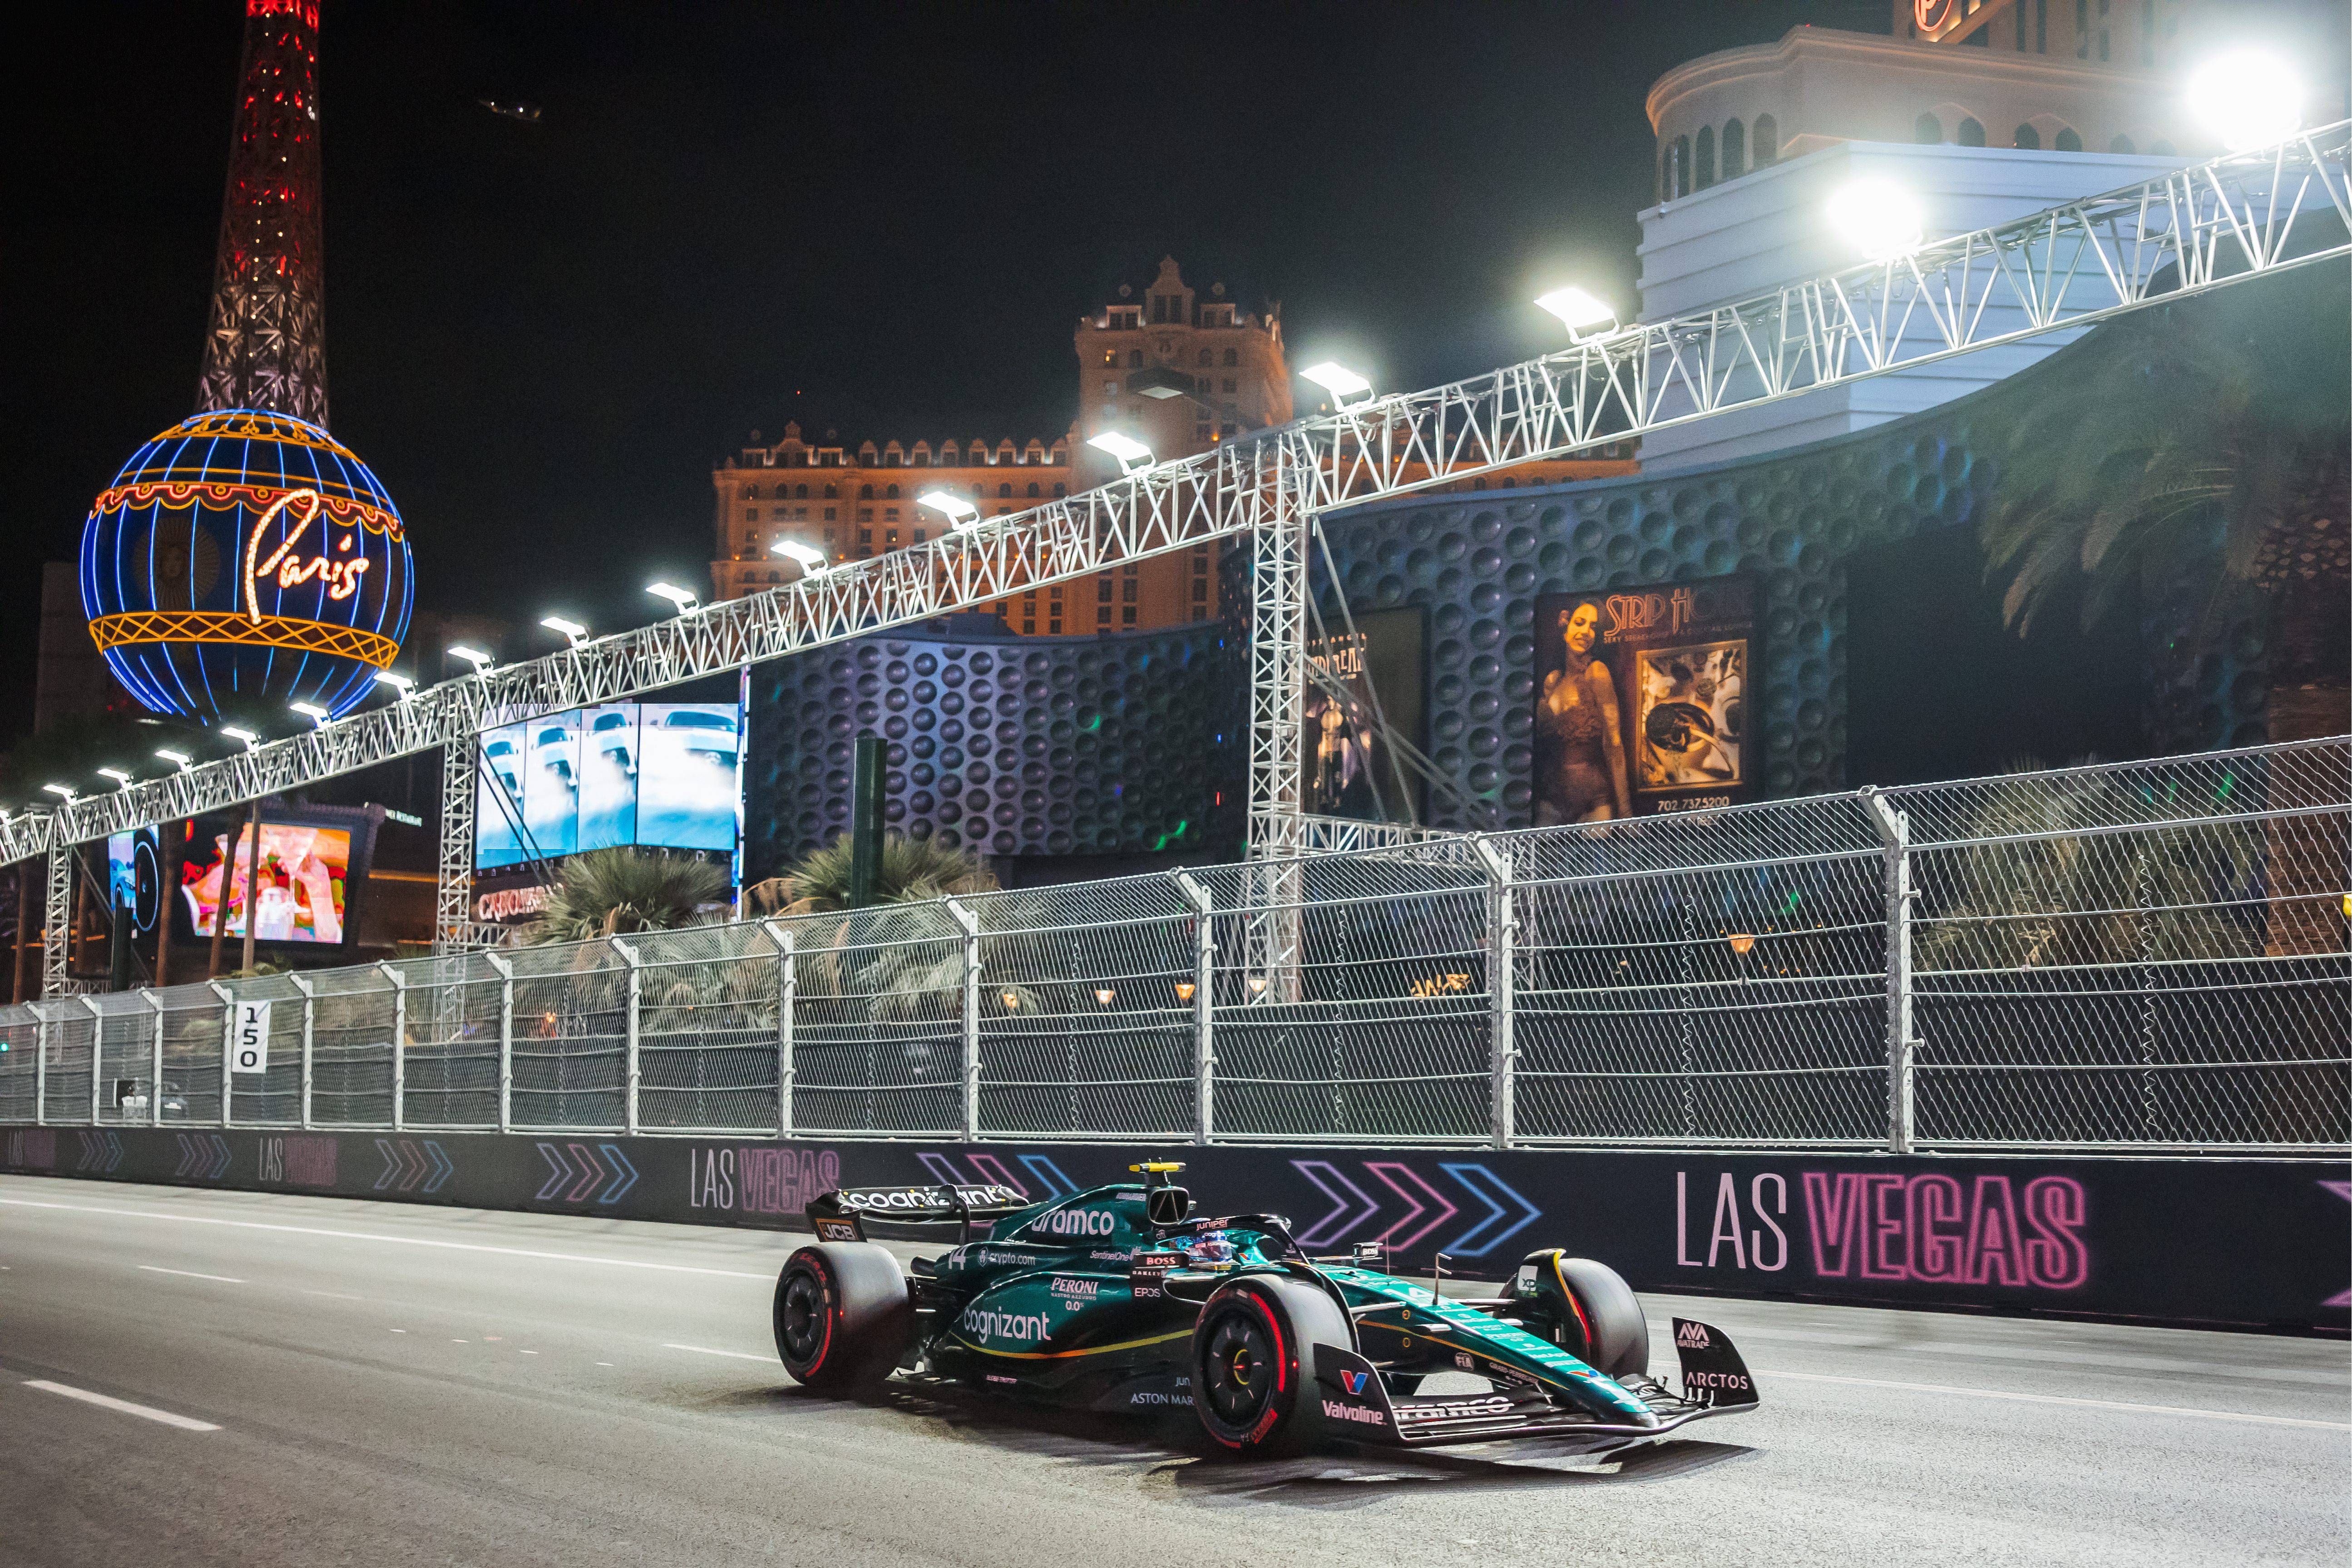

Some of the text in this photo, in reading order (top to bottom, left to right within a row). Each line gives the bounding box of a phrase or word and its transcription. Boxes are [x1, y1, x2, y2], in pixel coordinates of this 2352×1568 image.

[245, 488, 369, 625] Paris
[1603, 594, 1666, 636] STRIP
[1658, 796, 1729, 812] 702.737.5200
[240, 1006, 258, 1067] 150
[259, 1137, 283, 1181] LAS
[691, 1148, 840, 1214] LAS VEGAS
[824, 1224, 857, 1241] JCB
[1031, 1209, 1114, 1236] aramco
[1677, 1172, 2089, 1290] LAS VEGAS
[988, 1252, 1036, 1266] crypto.com
[1146, 1257, 1176, 1265] BOSS
[1050, 1277, 1099, 1294] PERONI
[964, 1305, 1052, 1344] cognizant
[1686, 1371, 1748, 1390] ARCTOS
[1130, 1393, 1194, 1405] ASTON MAR
[1322, 1400, 1384, 1425] Valvoline
